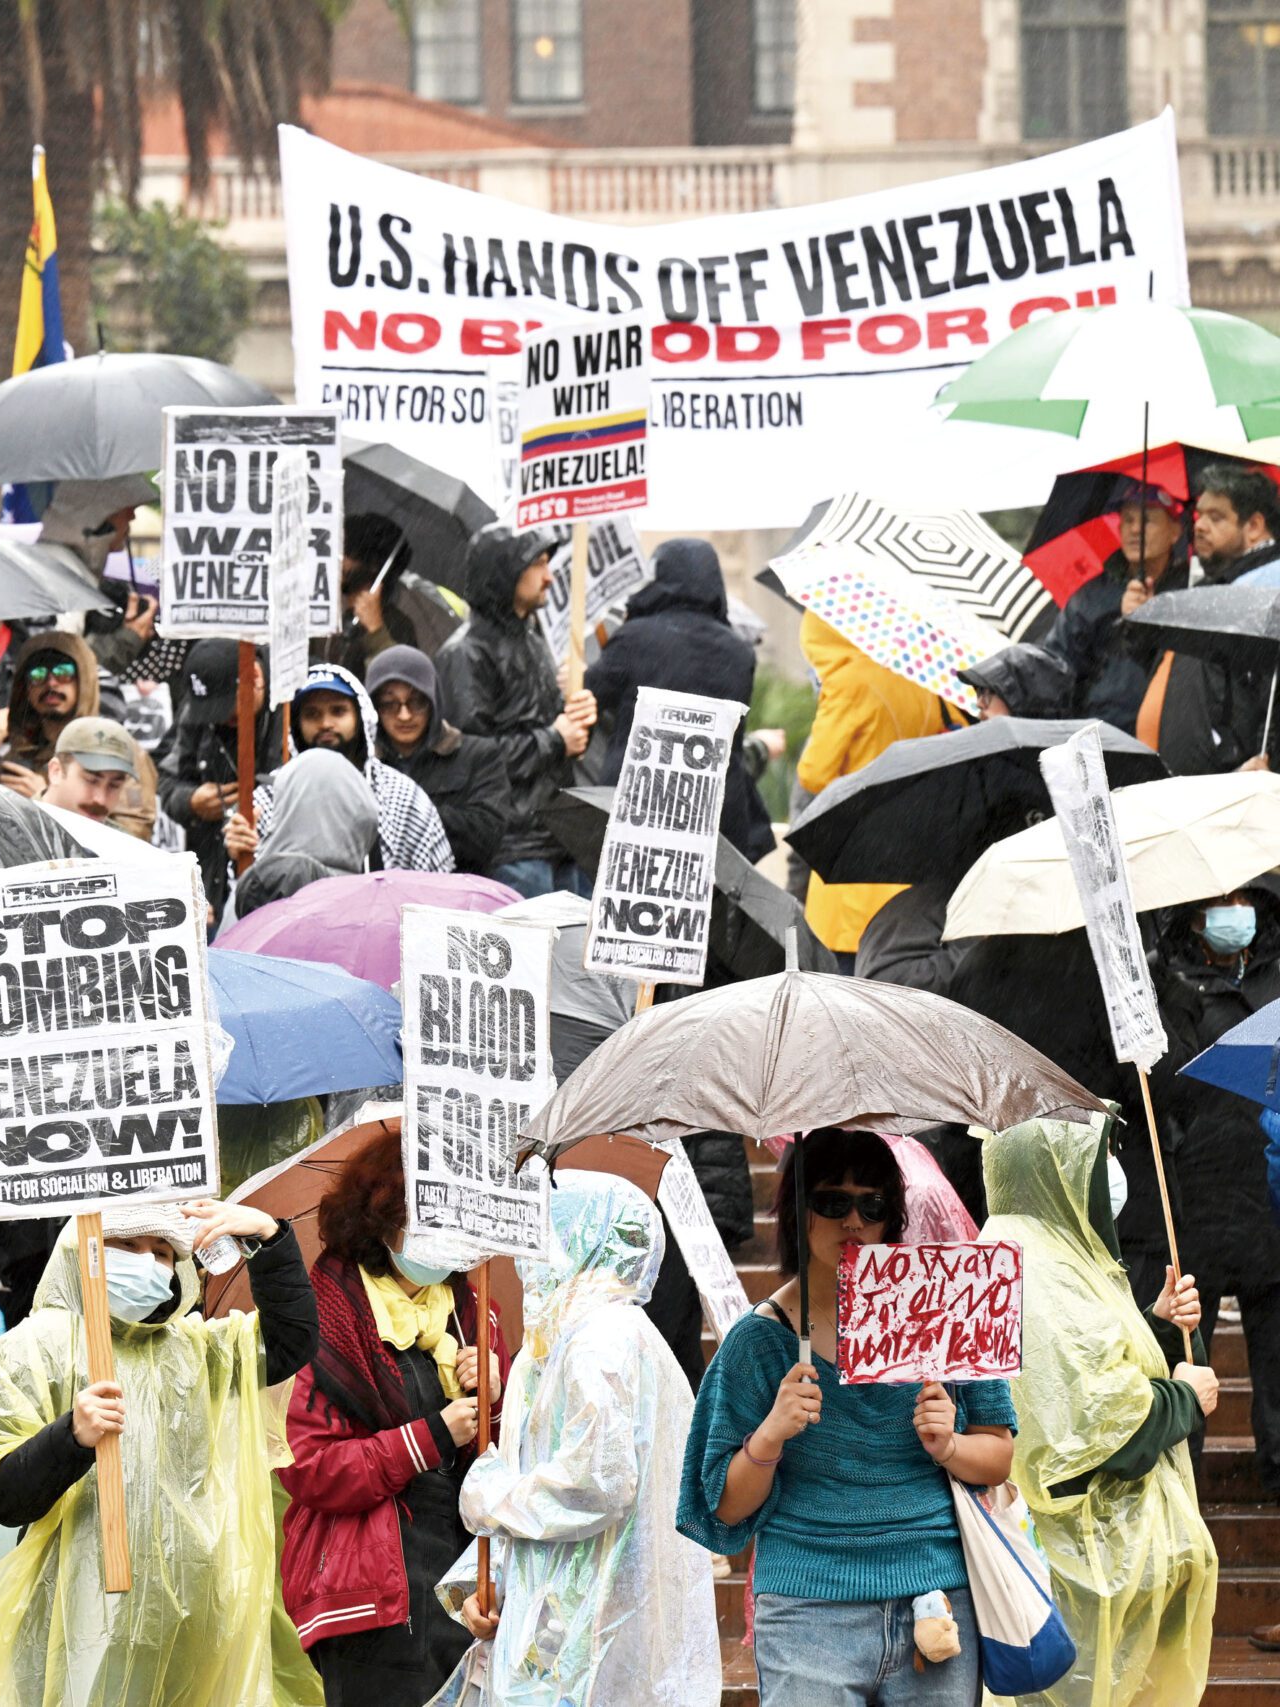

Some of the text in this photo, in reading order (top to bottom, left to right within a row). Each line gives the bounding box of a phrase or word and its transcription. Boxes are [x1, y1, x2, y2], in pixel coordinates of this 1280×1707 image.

[328, 203, 429, 293] U.S.
[443, 233, 644, 314] HANDS
[658, 247, 768, 324] OFF
[782, 177, 1135, 317] VENEZUELA
[323, 310, 442, 356] NO
[459, 317, 780, 363] BOD
[800, 307, 989, 361] FOR
[526, 324, 643, 389] NO WAR
[395, 385, 445, 425] FOR
[553, 379, 611, 418] WITH
[651, 390, 804, 430] IBERATION
[174, 449, 237, 514] NO
[520, 443, 646, 496] VENEZUELA!
[173, 560, 331, 601] VENEZA
[236, 552, 265, 564] ON
[628, 724, 728, 773] STOP
[616, 763, 723, 837] BOMBIN
[598, 895, 707, 944] NOW!
[446, 925, 513, 980] NO
[664, 949, 674, 967] &
[419, 973, 536, 1082] BLOOD
[417, 1084, 483, 1183] FOR
[14, 1179, 40, 1199] FOR
[41, 1171, 109, 1198] SOCIALISM
[111, 1171, 128, 1190] &
[130, 1161, 202, 1188] LIBERATION
[418, 1183, 447, 1205] PARTY
